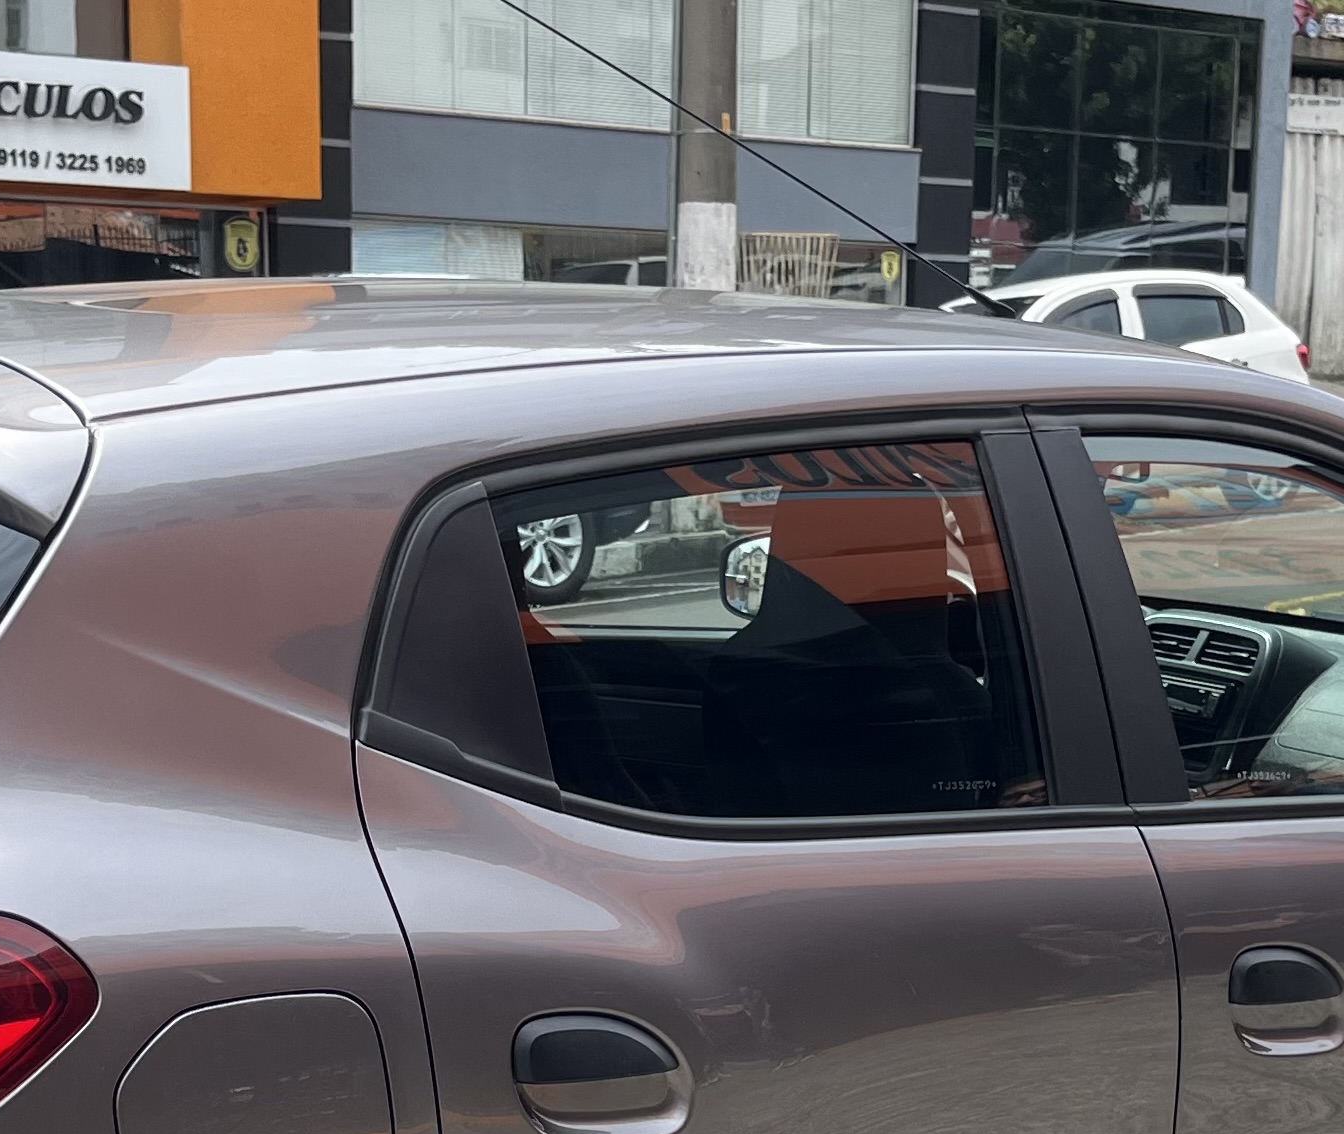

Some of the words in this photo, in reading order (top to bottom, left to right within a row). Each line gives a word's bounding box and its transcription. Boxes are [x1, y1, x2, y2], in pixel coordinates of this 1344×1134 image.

[44, 151, 52, 169] /
[56, 153, 99, 172] 3225
[106, 156, 146, 175] 1969
